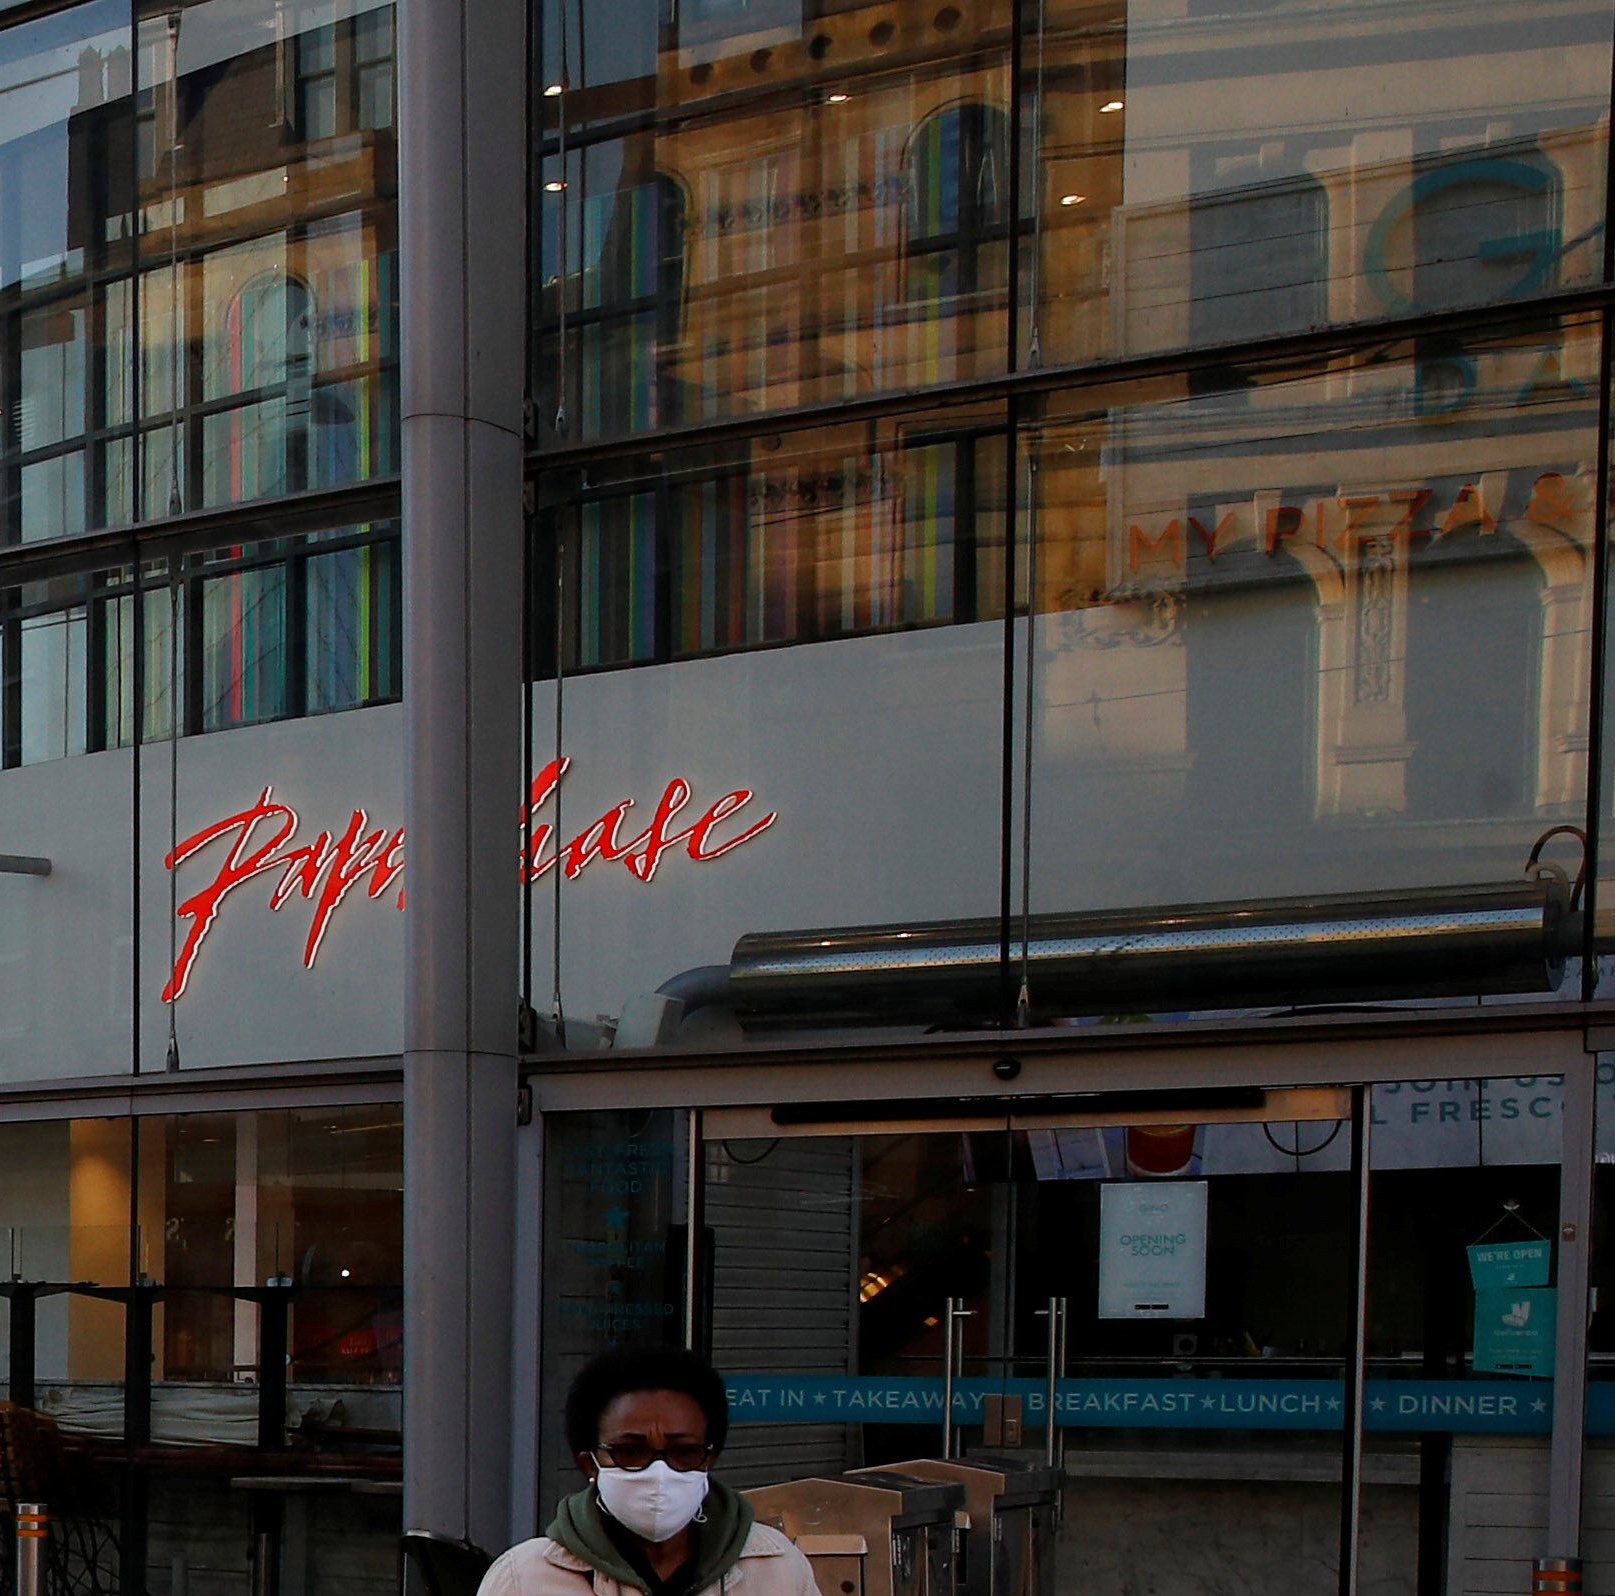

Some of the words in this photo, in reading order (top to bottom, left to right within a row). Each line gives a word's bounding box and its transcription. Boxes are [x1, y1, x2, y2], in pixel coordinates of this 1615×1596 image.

[1411, 1097, 1564, 1123] FRESC
[1119, 1233, 1186, 1246] OPENING
[1131, 1245, 1175, 1256] SOON
[1477, 1250, 1510, 1262] WE'RE
[1513, 1247, 1543, 1259] OPEN
[725, 1389, 772, 1407] EAT
[780, 1389, 805, 1407] IN
[832, 1389, 986, 1411] TAKEAWAY
[1029, 1392, 1195, 1413] BREAKFAST
[1220, 1394, 1321, 1414] LUNCH
[1398, 1394, 1518, 1416] DINNER
